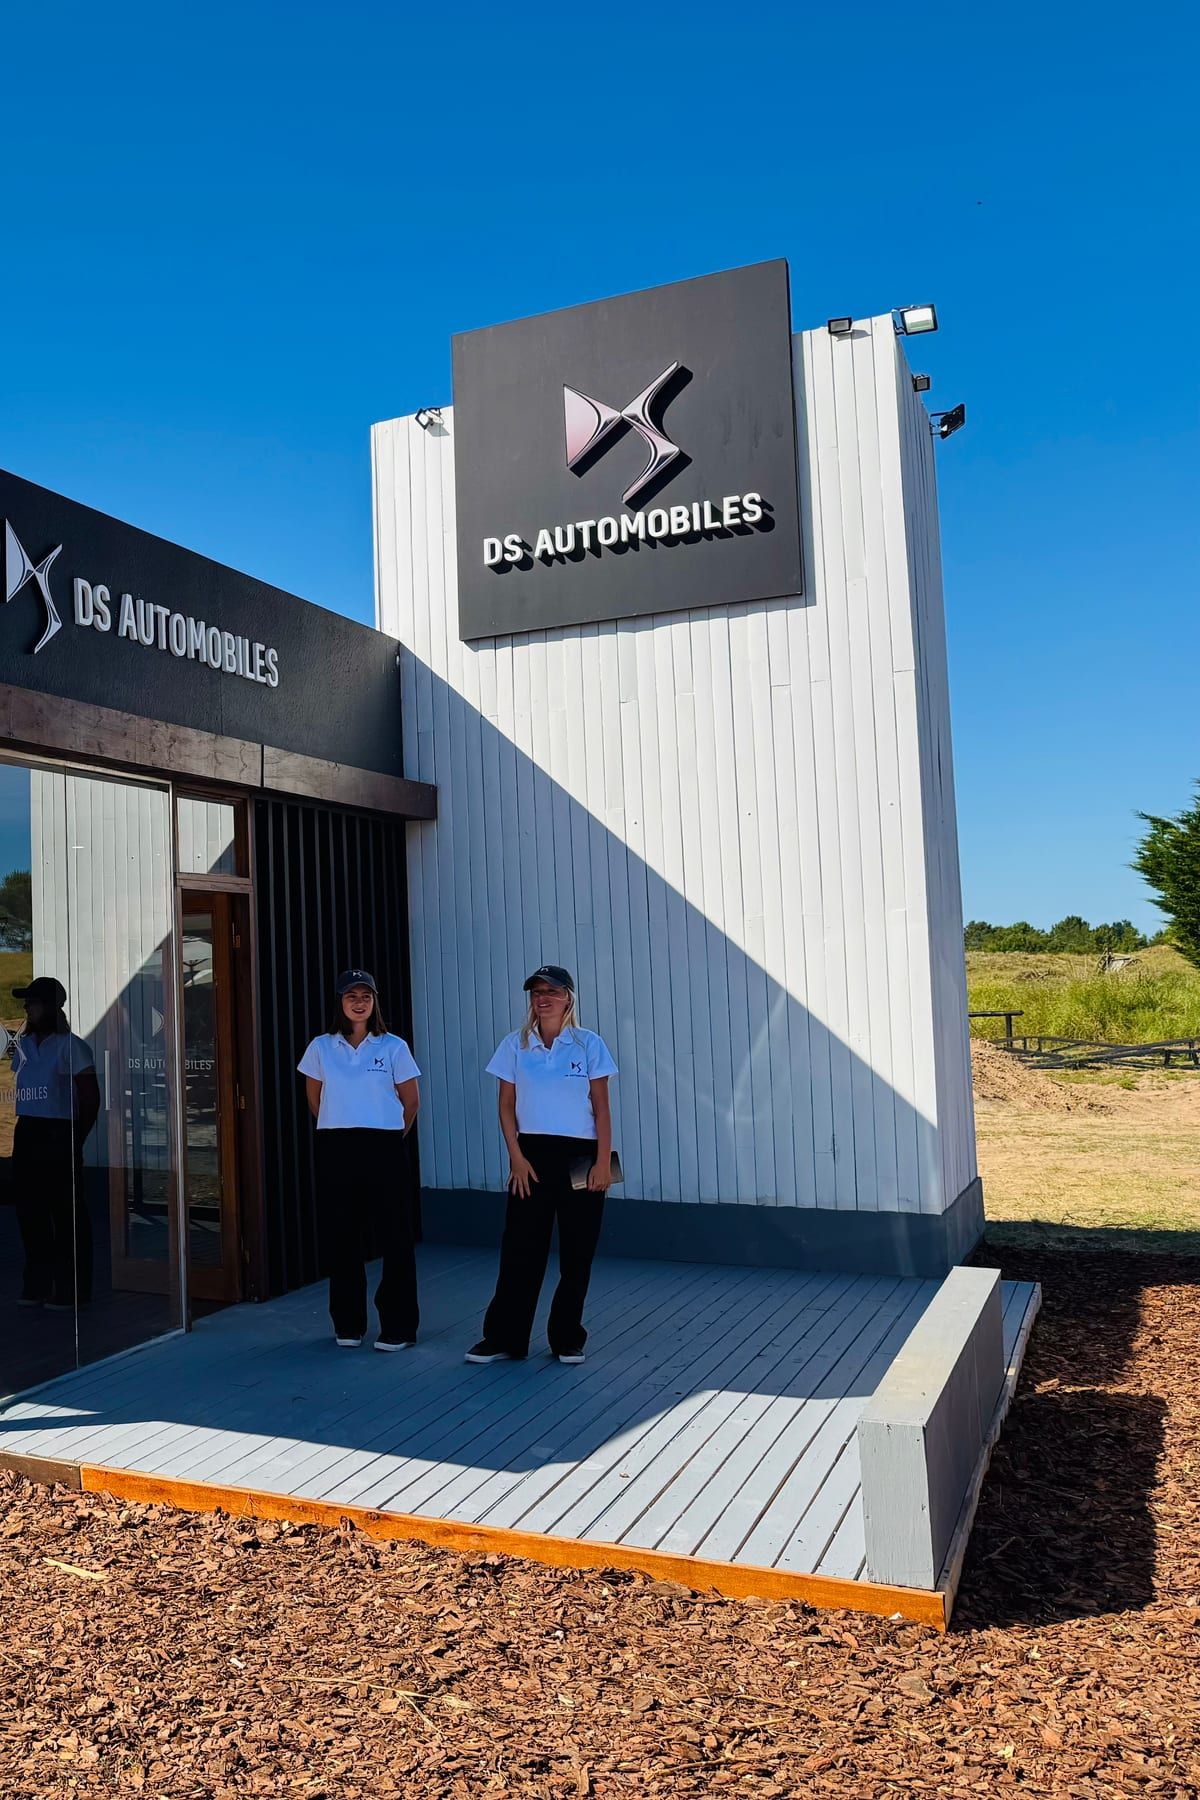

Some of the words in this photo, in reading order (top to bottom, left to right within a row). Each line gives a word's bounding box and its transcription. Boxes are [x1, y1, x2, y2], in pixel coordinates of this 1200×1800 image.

[483, 533, 524, 566] DS
[534, 492, 763, 558] AUTOMOBILES
[73, 577, 112, 632] DS
[118, 593, 279, 688] AUTOMOBILES
[128, 1058, 141, 1069] DS
[143, 1058, 212, 1071] AUTBILES
